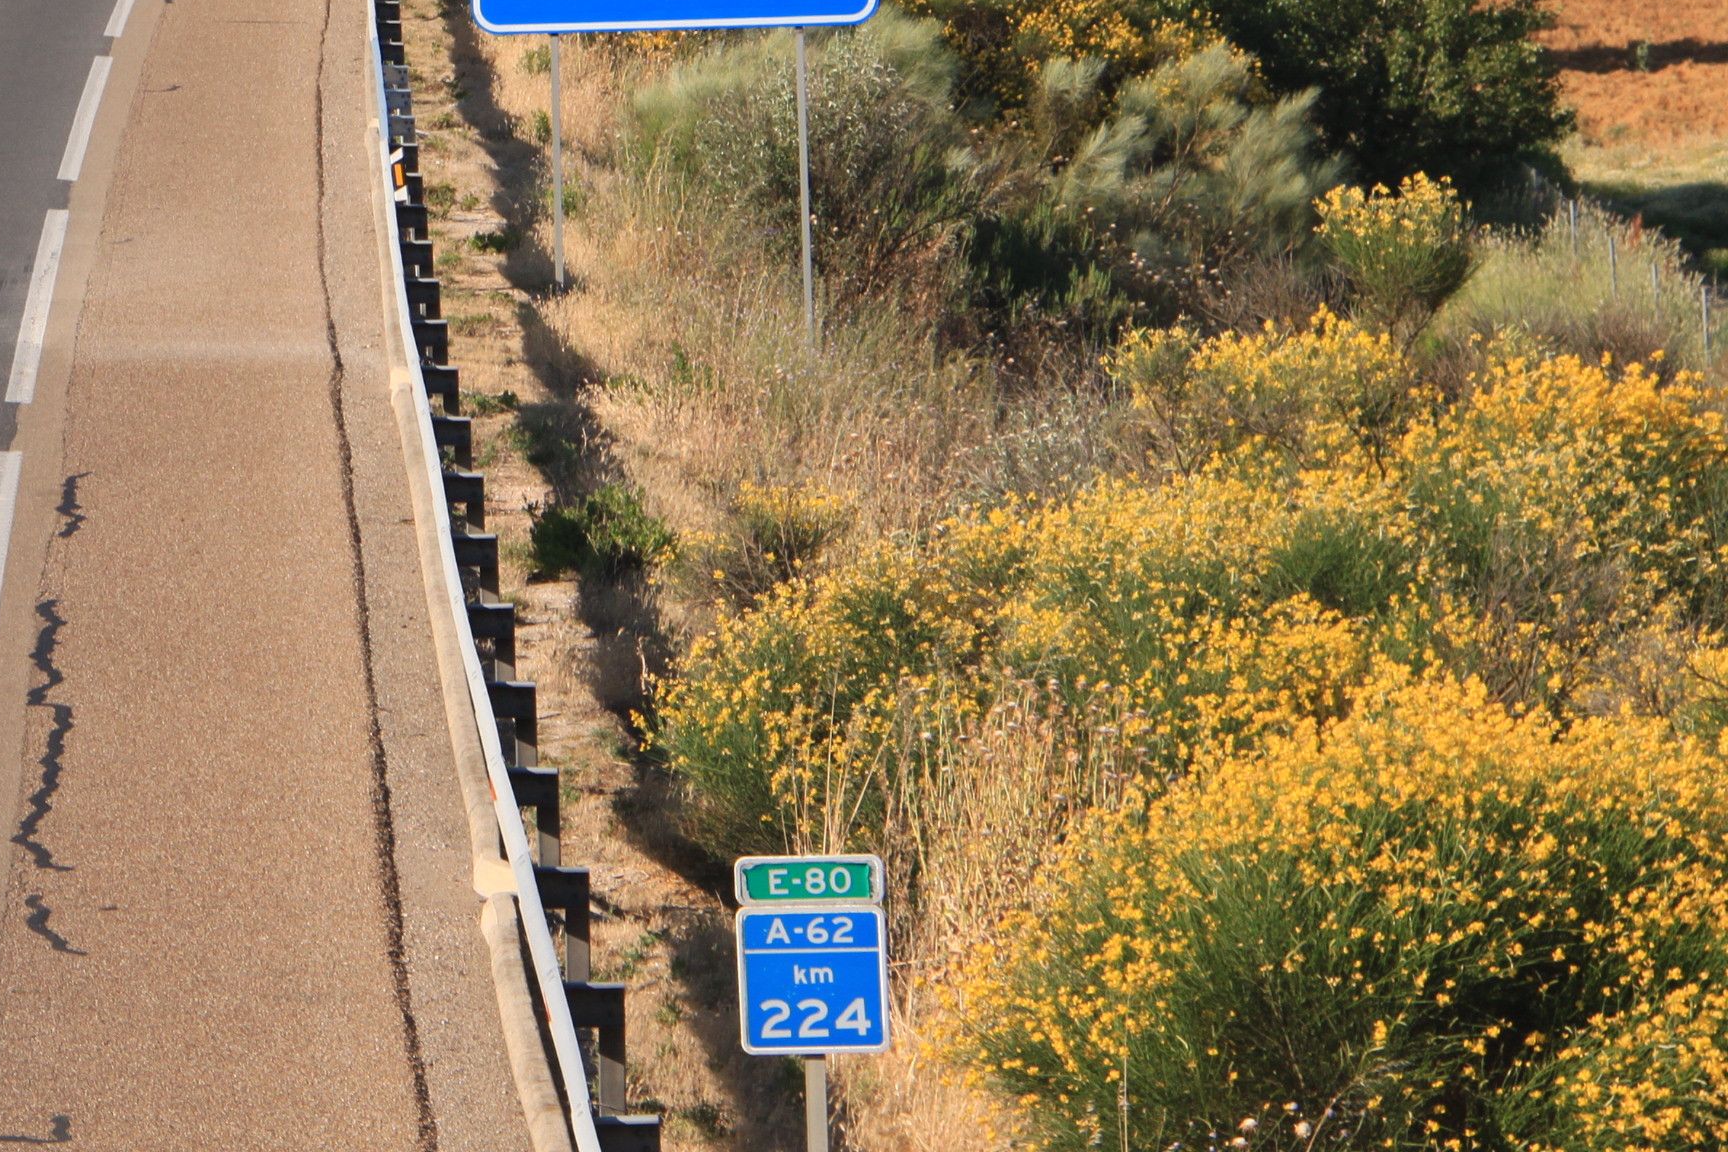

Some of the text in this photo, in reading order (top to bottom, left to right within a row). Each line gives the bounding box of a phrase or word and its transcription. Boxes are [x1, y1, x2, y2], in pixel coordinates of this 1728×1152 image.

[768, 866, 852, 895] E-80
[766, 916, 854, 944] A-62
[793, 964, 834, 985] km
[759, 998, 872, 1039] 224
